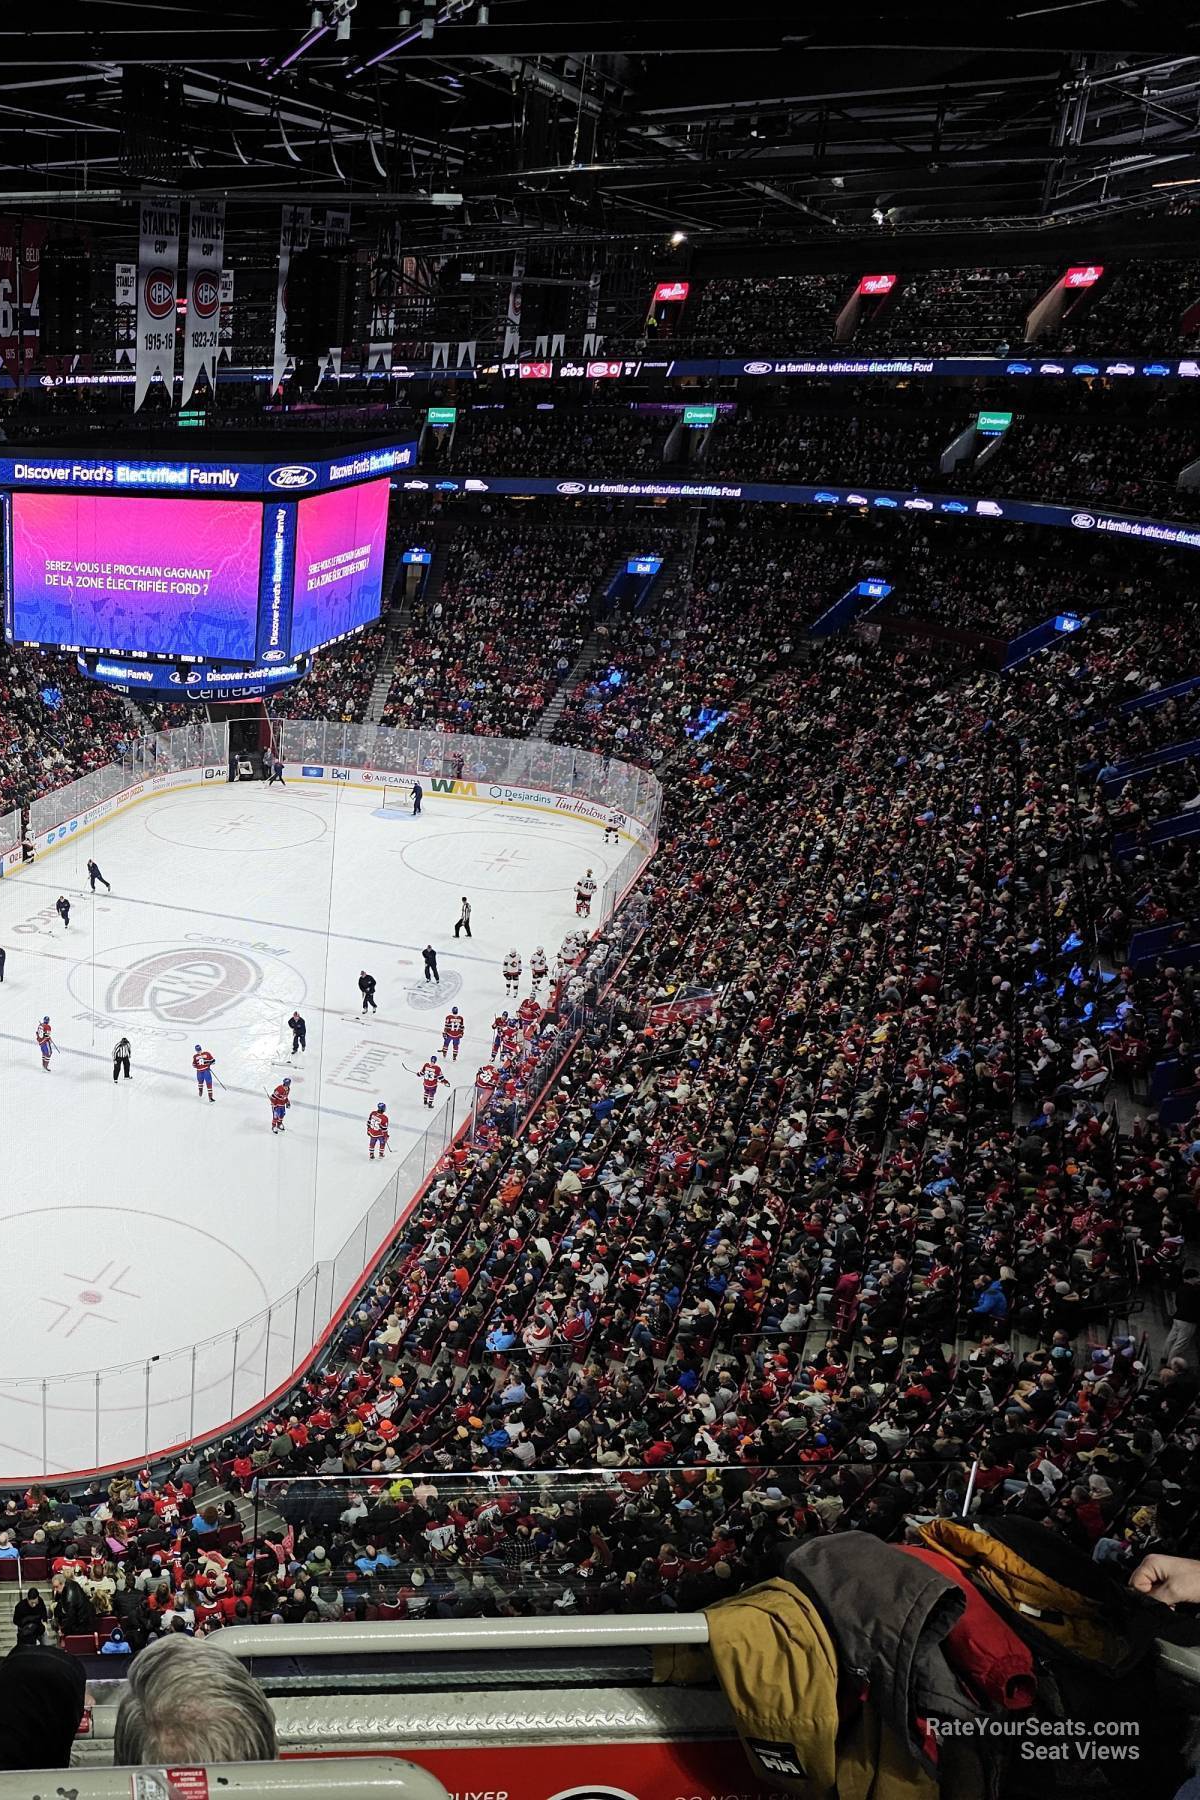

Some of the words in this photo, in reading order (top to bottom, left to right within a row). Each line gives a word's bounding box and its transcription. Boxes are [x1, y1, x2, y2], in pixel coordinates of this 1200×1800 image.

[143, 211, 179, 237] STANLEY
[191, 214, 224, 240] STANLEY
[155, 240, 167, 255] CUP
[202, 243, 213, 257] CUP
[116, 275, 135, 288] STANLEY
[144, 333, 173, 351] 1915-16
[191, 332, 218, 348] 1923-24
[522, 366, 531, 375] 0
[560, 367, 584, 377] 9:03
[609, 366, 618, 375] 0
[775, 363, 786, 372] La
[787, 363, 815, 373] famille
[816, 363, 828, 372] de
[829, 362, 868, 373] véhicules
[869, 362, 912, 372] électrifiés
[913, 362, 933, 372] Ford
[330, 464, 353, 480] Discover
[354, 459, 369, 475] Ford's
[370, 453, 393, 473] Electrified
[394, 449, 410, 466] Family
[14, 464, 70, 481] Discover
[73, 465, 113, 482] Ford's
[117, 467, 187, 485] Electrified
[190, 468, 239, 488] Family
[588, 484, 599, 493] La
[600, 484, 628, 493] famille
[629, 484, 640, 493] de
[641, 484, 680, 495] véhicules
[681, 485, 721, 496] électrifiés
[722, 487, 741, 497] Ford
[276, 509, 286, 538] Family
[1097, 519, 1106, 528] La
[1107, 520, 1131, 533] famille
[1131, 523, 1141, 535] de
[1142, 525, 1176, 541] véhicules
[273, 538, 283, 582] Electrified
[411, 554, 422, 562] Bell
[101, 564, 112, 574] LE
[114, 565, 162, 577] PROCHAIN
[164, 567, 212, 580] GAGNANT
[637, 563, 650, 572] Bell
[45, 575, 58, 586] DE
[60, 576, 73, 587] LA
[76, 577, 104, 589] ZONE
[106, 577, 168, 593] ÉLECTRIFIÉE
[170, 582, 200, 595] FORD
[202, 584, 208, 595] ?
[307, 578, 315, 591] DE
[315, 576, 321, 588] LA
[321, 573, 333, 586] ZONE
[272, 584, 281, 608] Ford's
[270, 609, 279, 645] Discover
[127, 668, 153, 682] Family
[207, 670, 243, 682] Discover
[332, 768, 349, 780] Bell
[374, 775, 386, 783] AIR
[387, 775, 420, 786] CANADA
[431, 778, 478, 797] WM
[505, 789, 551, 804] Desjardins
[555, 796, 572, 811] Tim
[572, 800, 607, 821] Hortons
[343, 1048, 399, 1085] intact
[760, 1754, 801, 1775] HH
